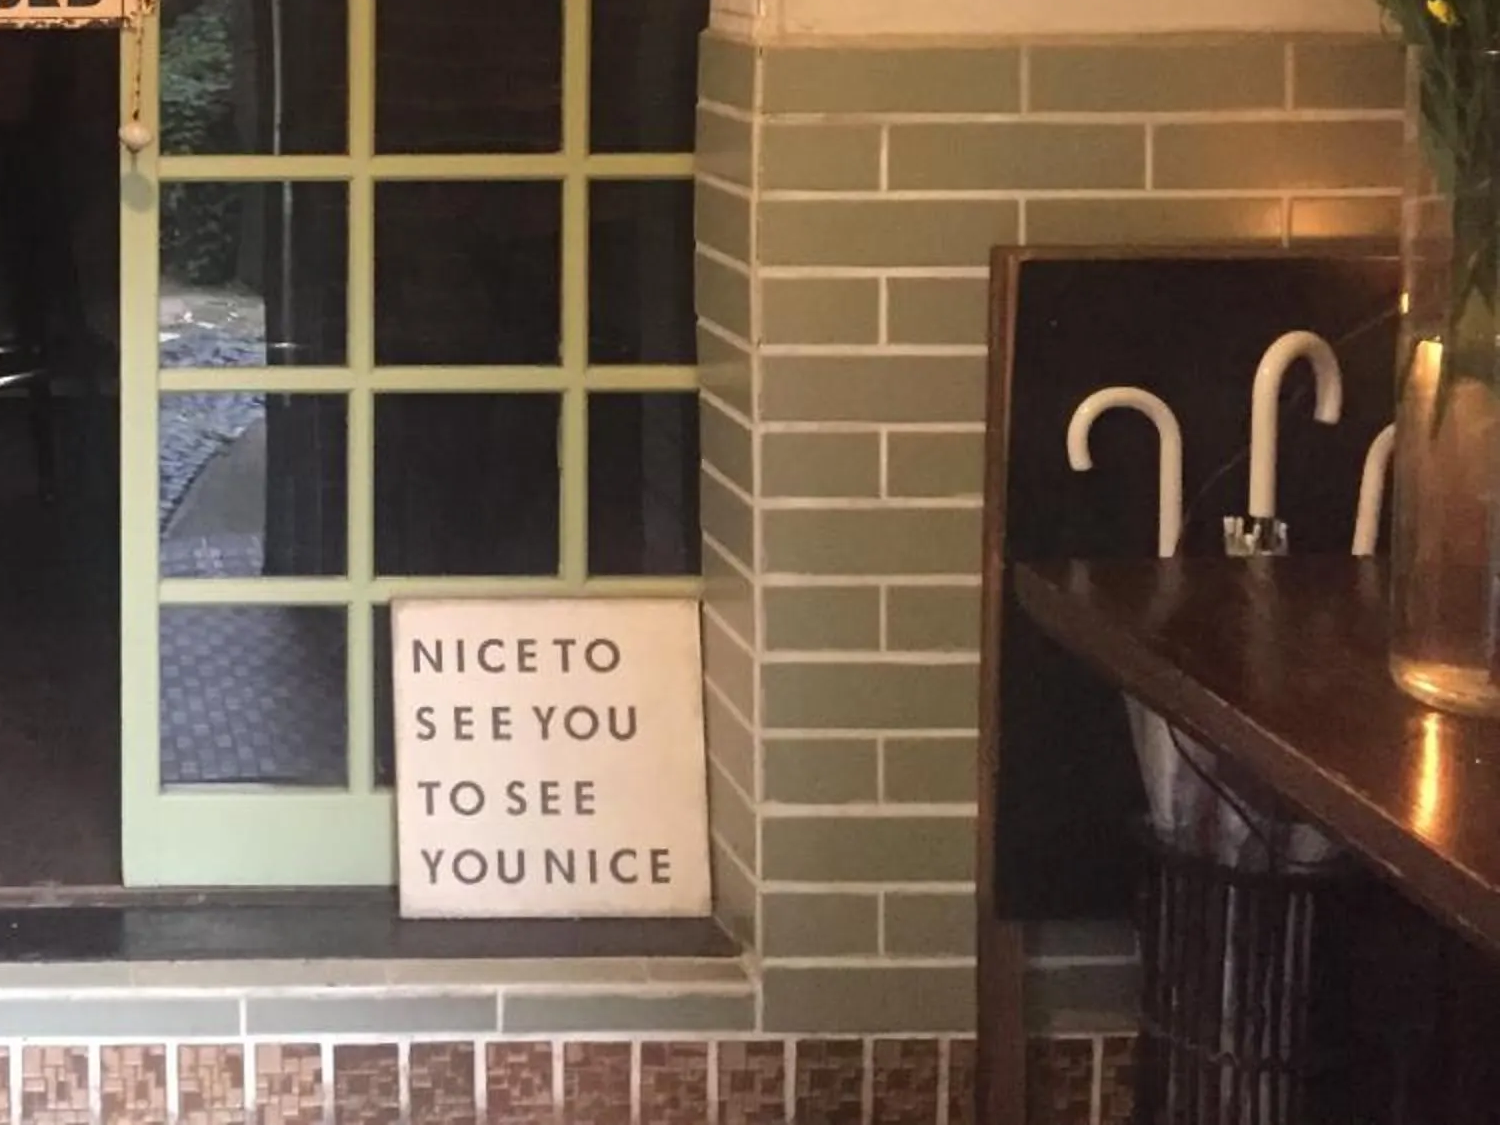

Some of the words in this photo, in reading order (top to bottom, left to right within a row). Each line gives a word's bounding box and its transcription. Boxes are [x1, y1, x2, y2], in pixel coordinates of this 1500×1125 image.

[412, 638, 537, 673] NICE
[552, 638, 621, 673] TO
[415, 705, 513, 741] SEE
[532, 705, 637, 741] YOU
[417, 780, 486, 816] TO
[505, 780, 596, 816] SEE
[420, 848, 526, 885] YOU
[545, 848, 672, 884] NICE
